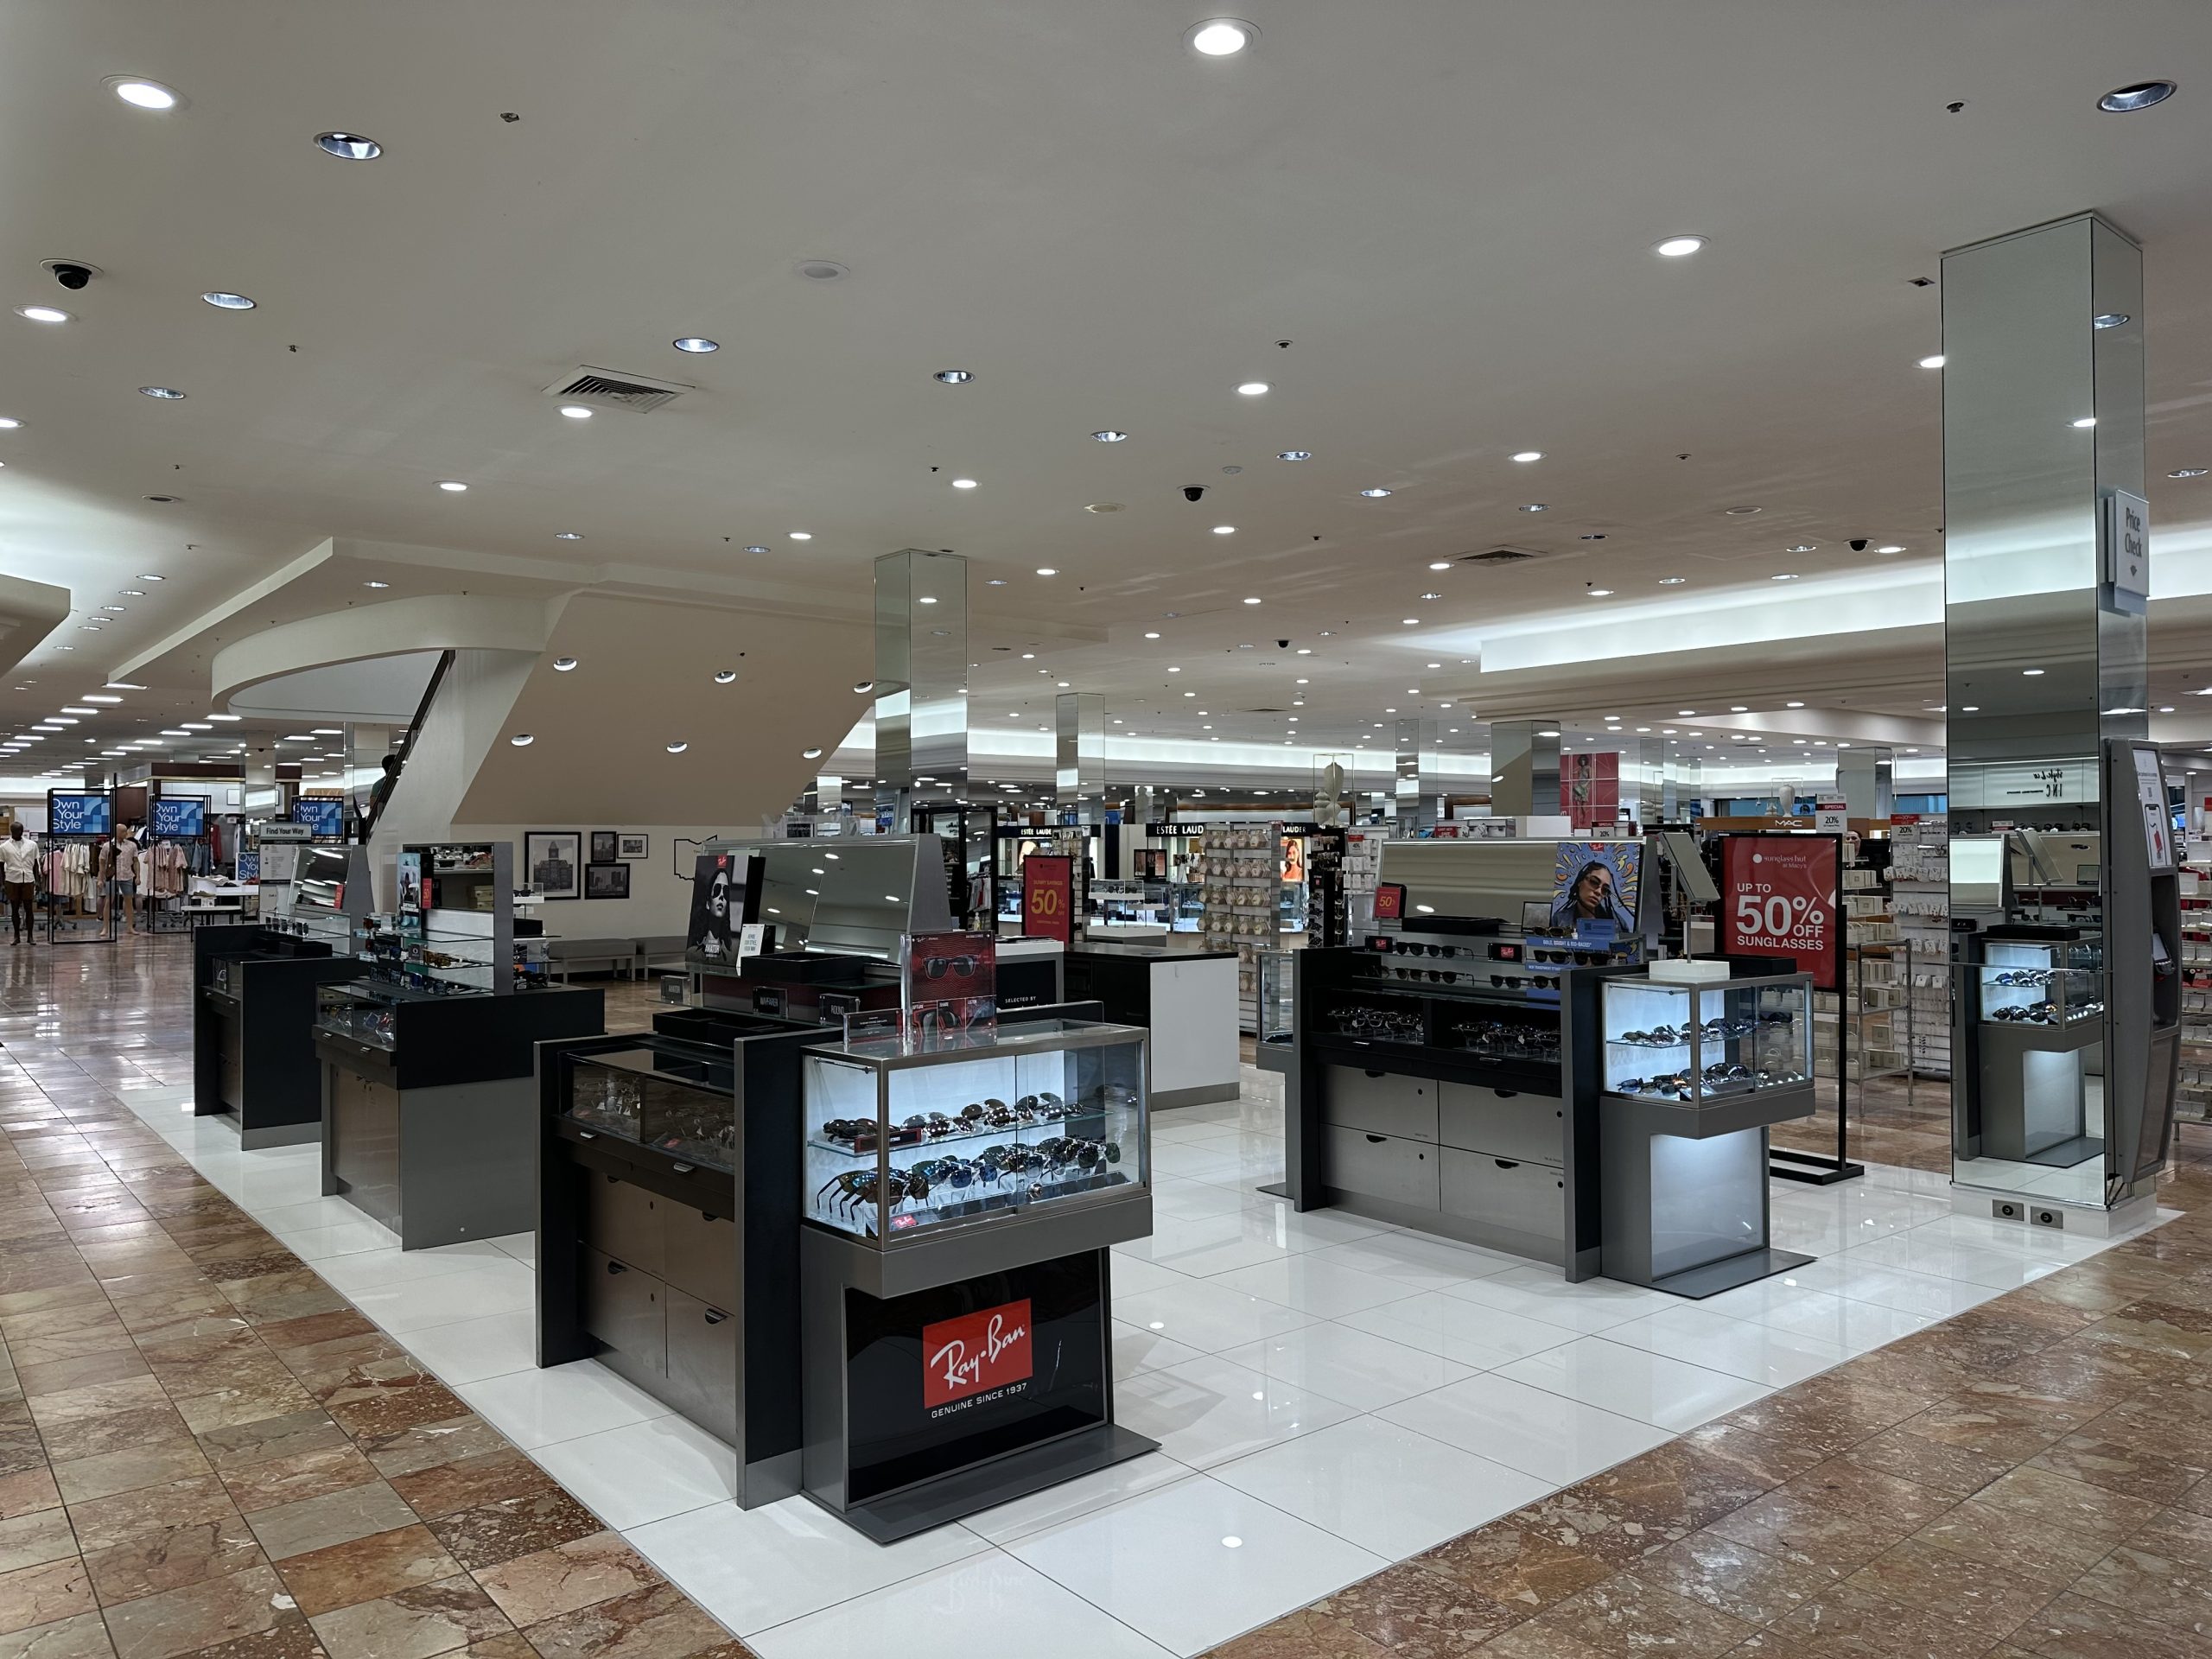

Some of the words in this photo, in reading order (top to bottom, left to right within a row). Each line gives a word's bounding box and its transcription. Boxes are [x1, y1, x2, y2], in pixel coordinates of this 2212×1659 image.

[2126, 506, 2141, 532] Price
[2125, 533, 2143, 558] Check
[53, 798, 79, 810] Own
[154, 804, 178, 813] Own
[57, 809, 84, 819] Your
[158, 812, 181, 823] Your
[53, 818, 81, 831] Style
[1825, 816, 1840, 824] 20%
[155, 822, 179, 833] Style
[1156, 824, 1178, 835] ESTÉE
[1182, 825, 1205, 835] LAUD
[1764, 855, 1794, 863] sunglass
[245, 862, 259, 871] Yo
[238, 870, 259, 880] Styl
[1737, 883, 1753, 893] UP
[1755, 883, 1771, 893] TO
[1736, 894, 1825, 937] 50%
[1793, 924, 1824, 938] OFF
[1737, 935, 1824, 950] SUNGLASSES
[930, 1313, 1026, 1390] Ray-Ban
[931, 1399, 973, 1419] GENUINE
[976, 1389, 1004, 1404] SINCE
[1007, 1382, 1027, 1395] 1937
